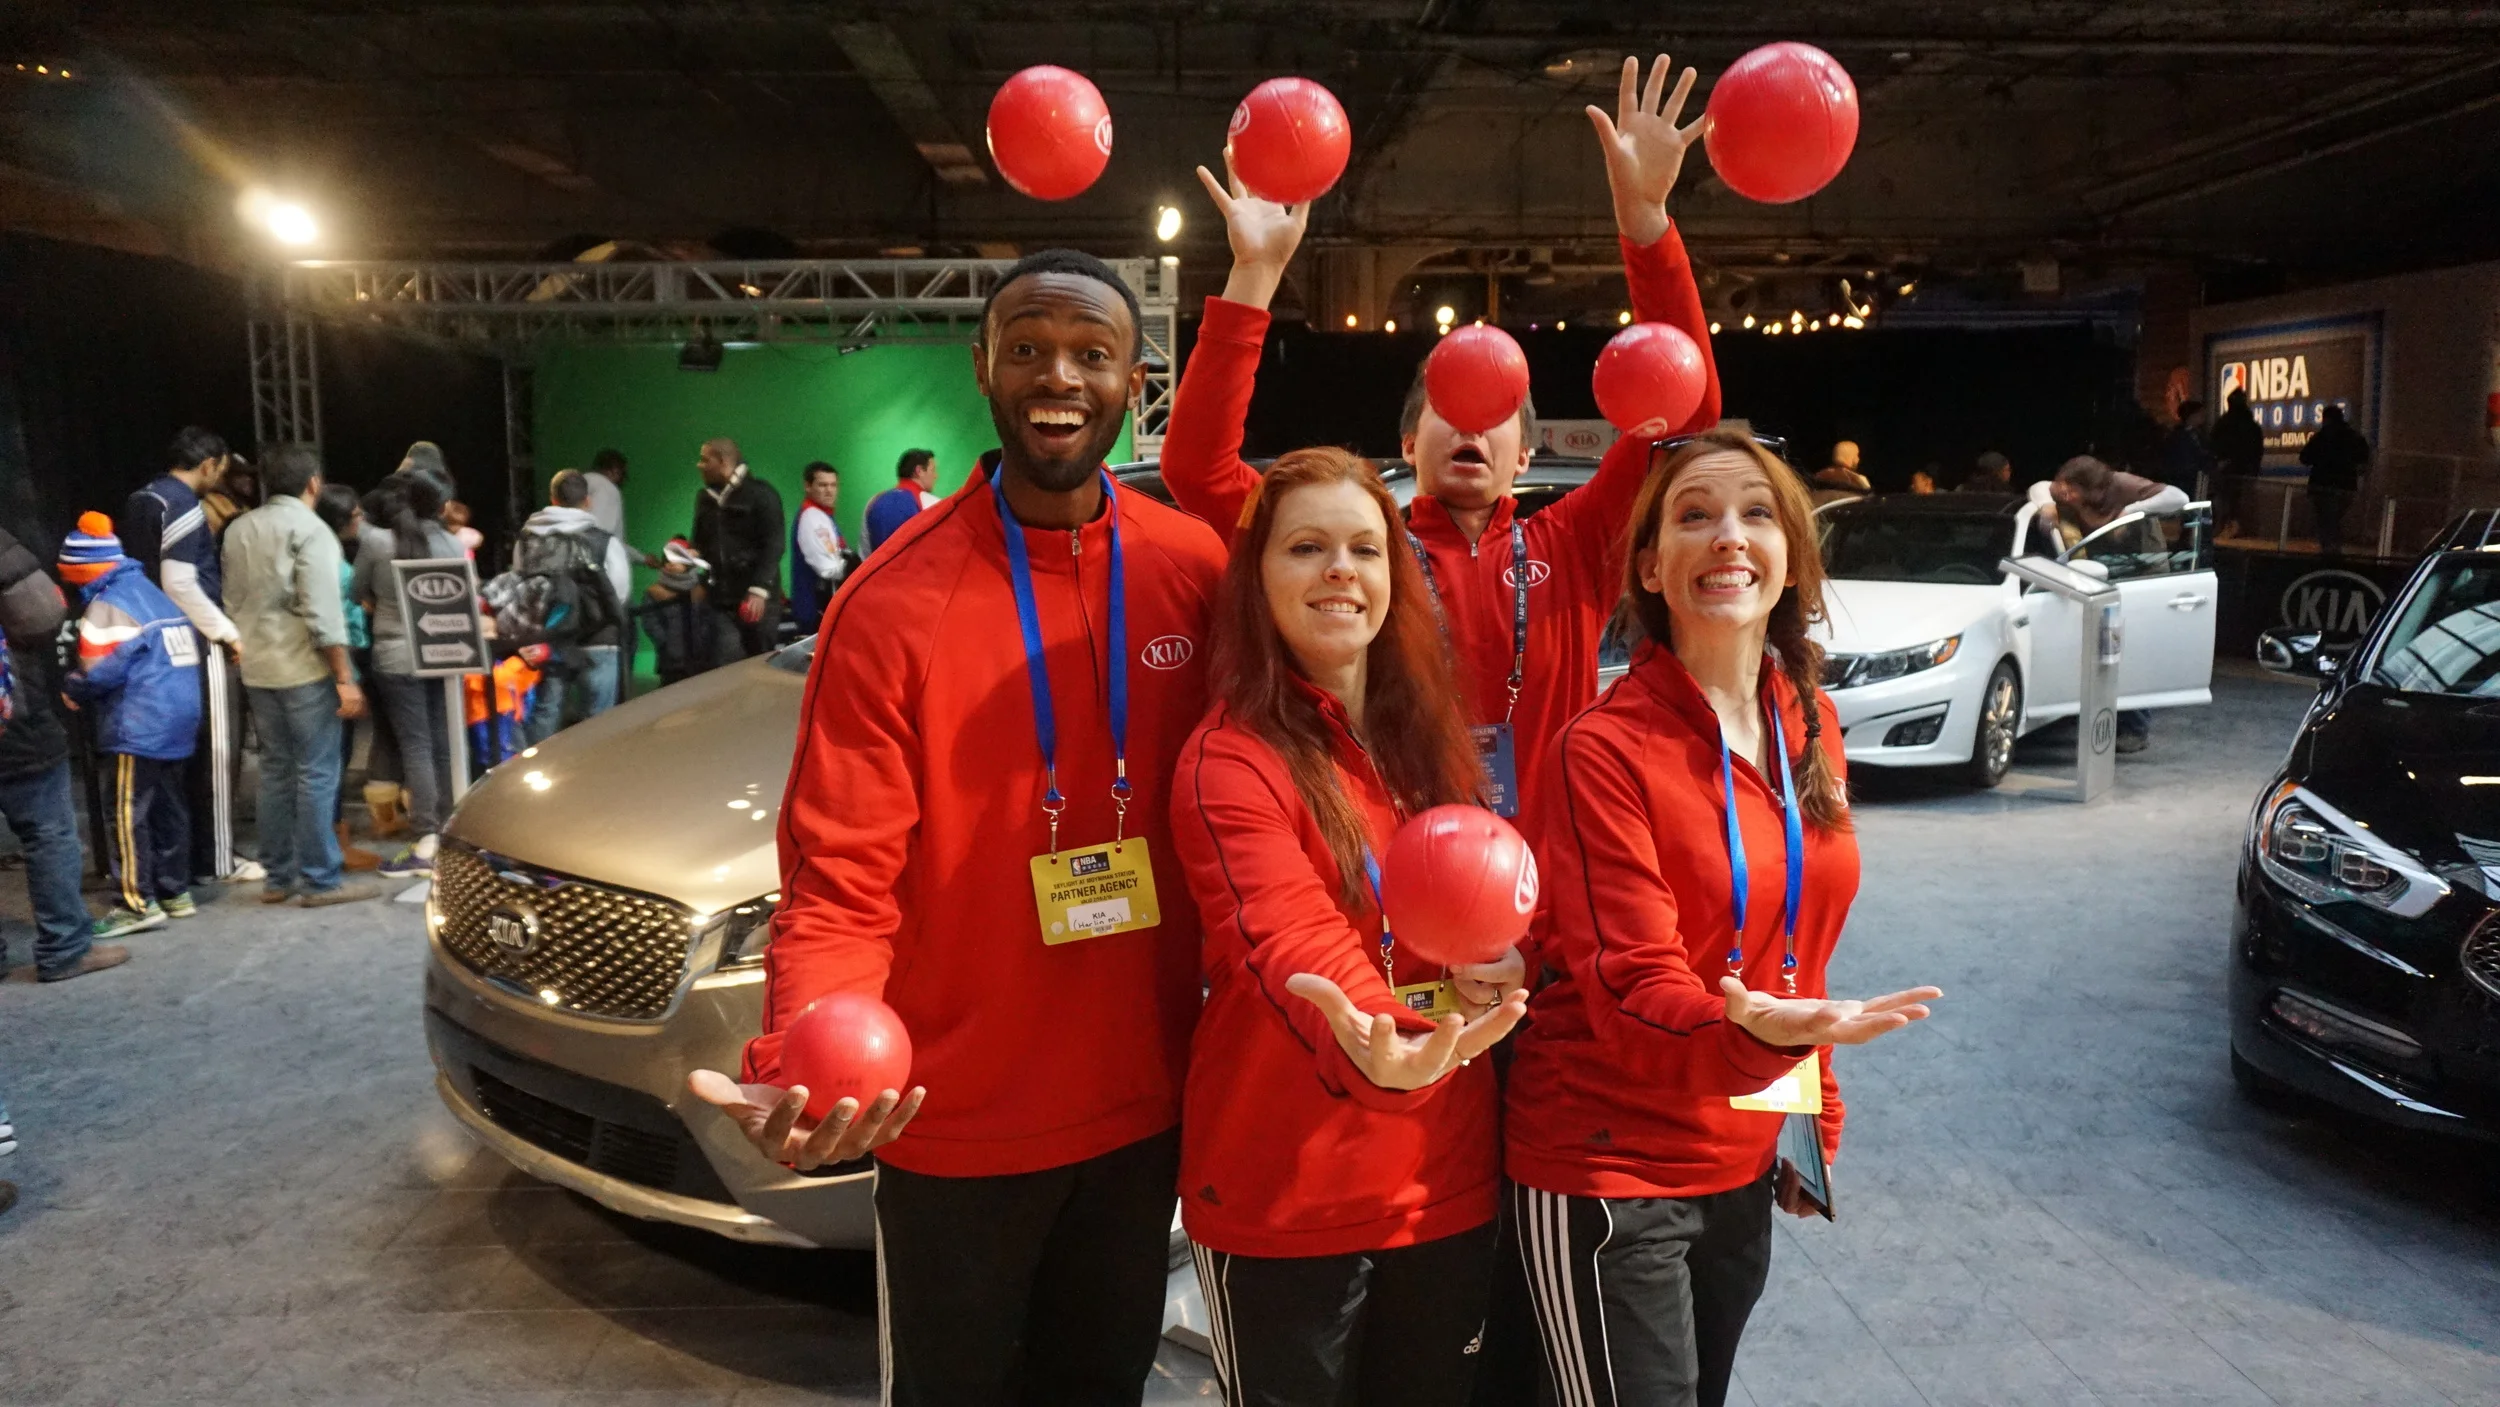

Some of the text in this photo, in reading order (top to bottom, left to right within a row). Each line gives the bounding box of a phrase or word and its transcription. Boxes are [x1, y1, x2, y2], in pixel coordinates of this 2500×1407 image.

[2250, 355, 2310, 402] NBA
[1571, 434, 1595, 447] KIA
[417, 579, 459, 596] KIA
[2298, 586, 2367, 636] KIA
[427, 648, 463, 657] Video
[1150, 641, 1186, 665] KIA
[2095, 717, 2111, 746] KIA
[1080, 855, 1097, 866] NBA
[1114, 869, 1136, 879] STATION
[1050, 885, 1097, 903] PARTNER
[1100, 877, 1139, 893] AGENCY
[1092, 911, 1106, 919] KIA
[489, 915, 524, 948] KIA
[1413, 993, 1426, 1002] NBA
